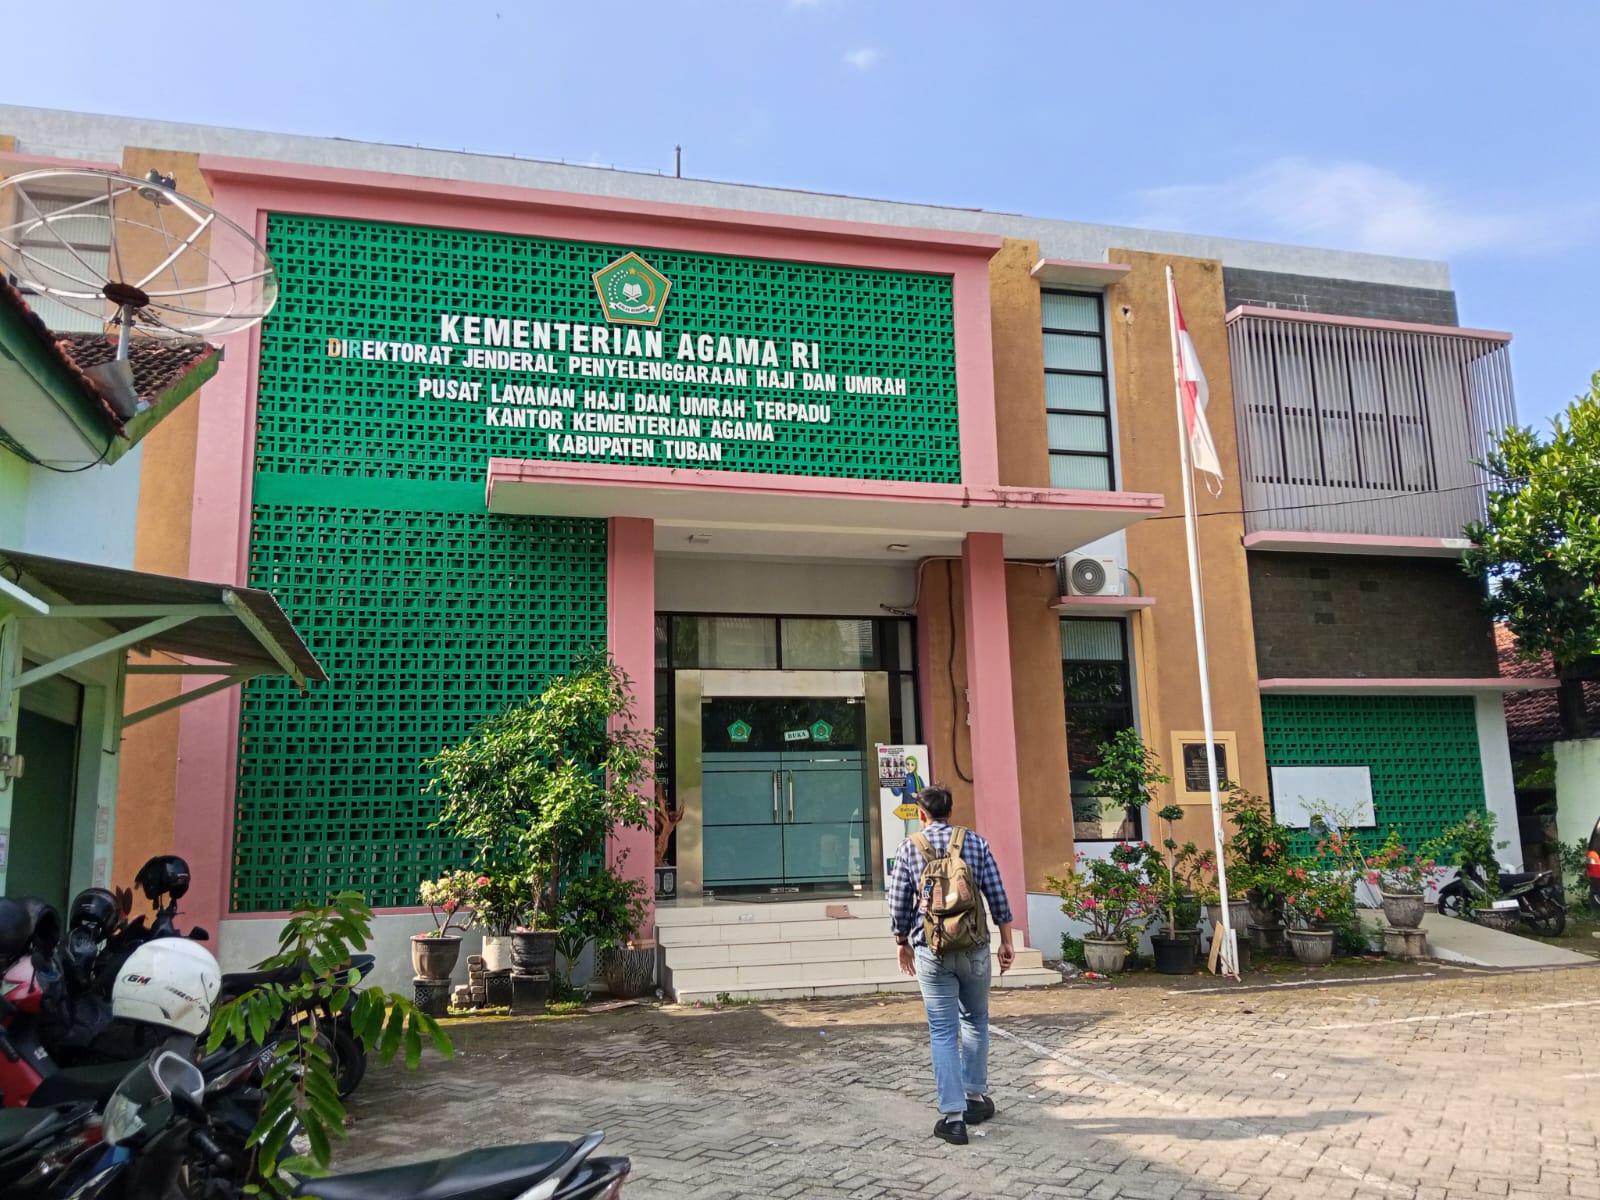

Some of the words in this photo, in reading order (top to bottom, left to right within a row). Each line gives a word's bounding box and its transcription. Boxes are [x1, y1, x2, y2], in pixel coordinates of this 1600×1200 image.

[440, 314, 662, 358] KEMENTERIAN
[677, 333, 779, 367] AGAMA
[792, 341, 819, 369] RI
[327, 338, 453, 365] DIREKTORAT
[462, 349, 558, 374] JENDERAL
[569, 356, 747, 386] PENYELENGGARAAN
[756, 369, 794, 389] HAJI
[803, 373, 836, 392] DAN
[845, 375, 906, 396] UMRAH
[419, 378, 482, 401] PUSAT
[491, 383, 575, 408] LAYANAN
[584, 390, 626, 411] HAJI
[634, 393, 670, 413] DAN
[680, 396, 745, 418] UMRAH
[754, 401, 831, 423] TERPADU
[486, 407, 563, 430] KANTOR
[573, 412, 700, 437] KEMENTERIAN
[710, 420, 774, 441] AGAMA
[548, 433, 654, 458] KABUPATEN
[663, 440, 722, 461] TUBAN
[127, 974, 152, 985] GM
